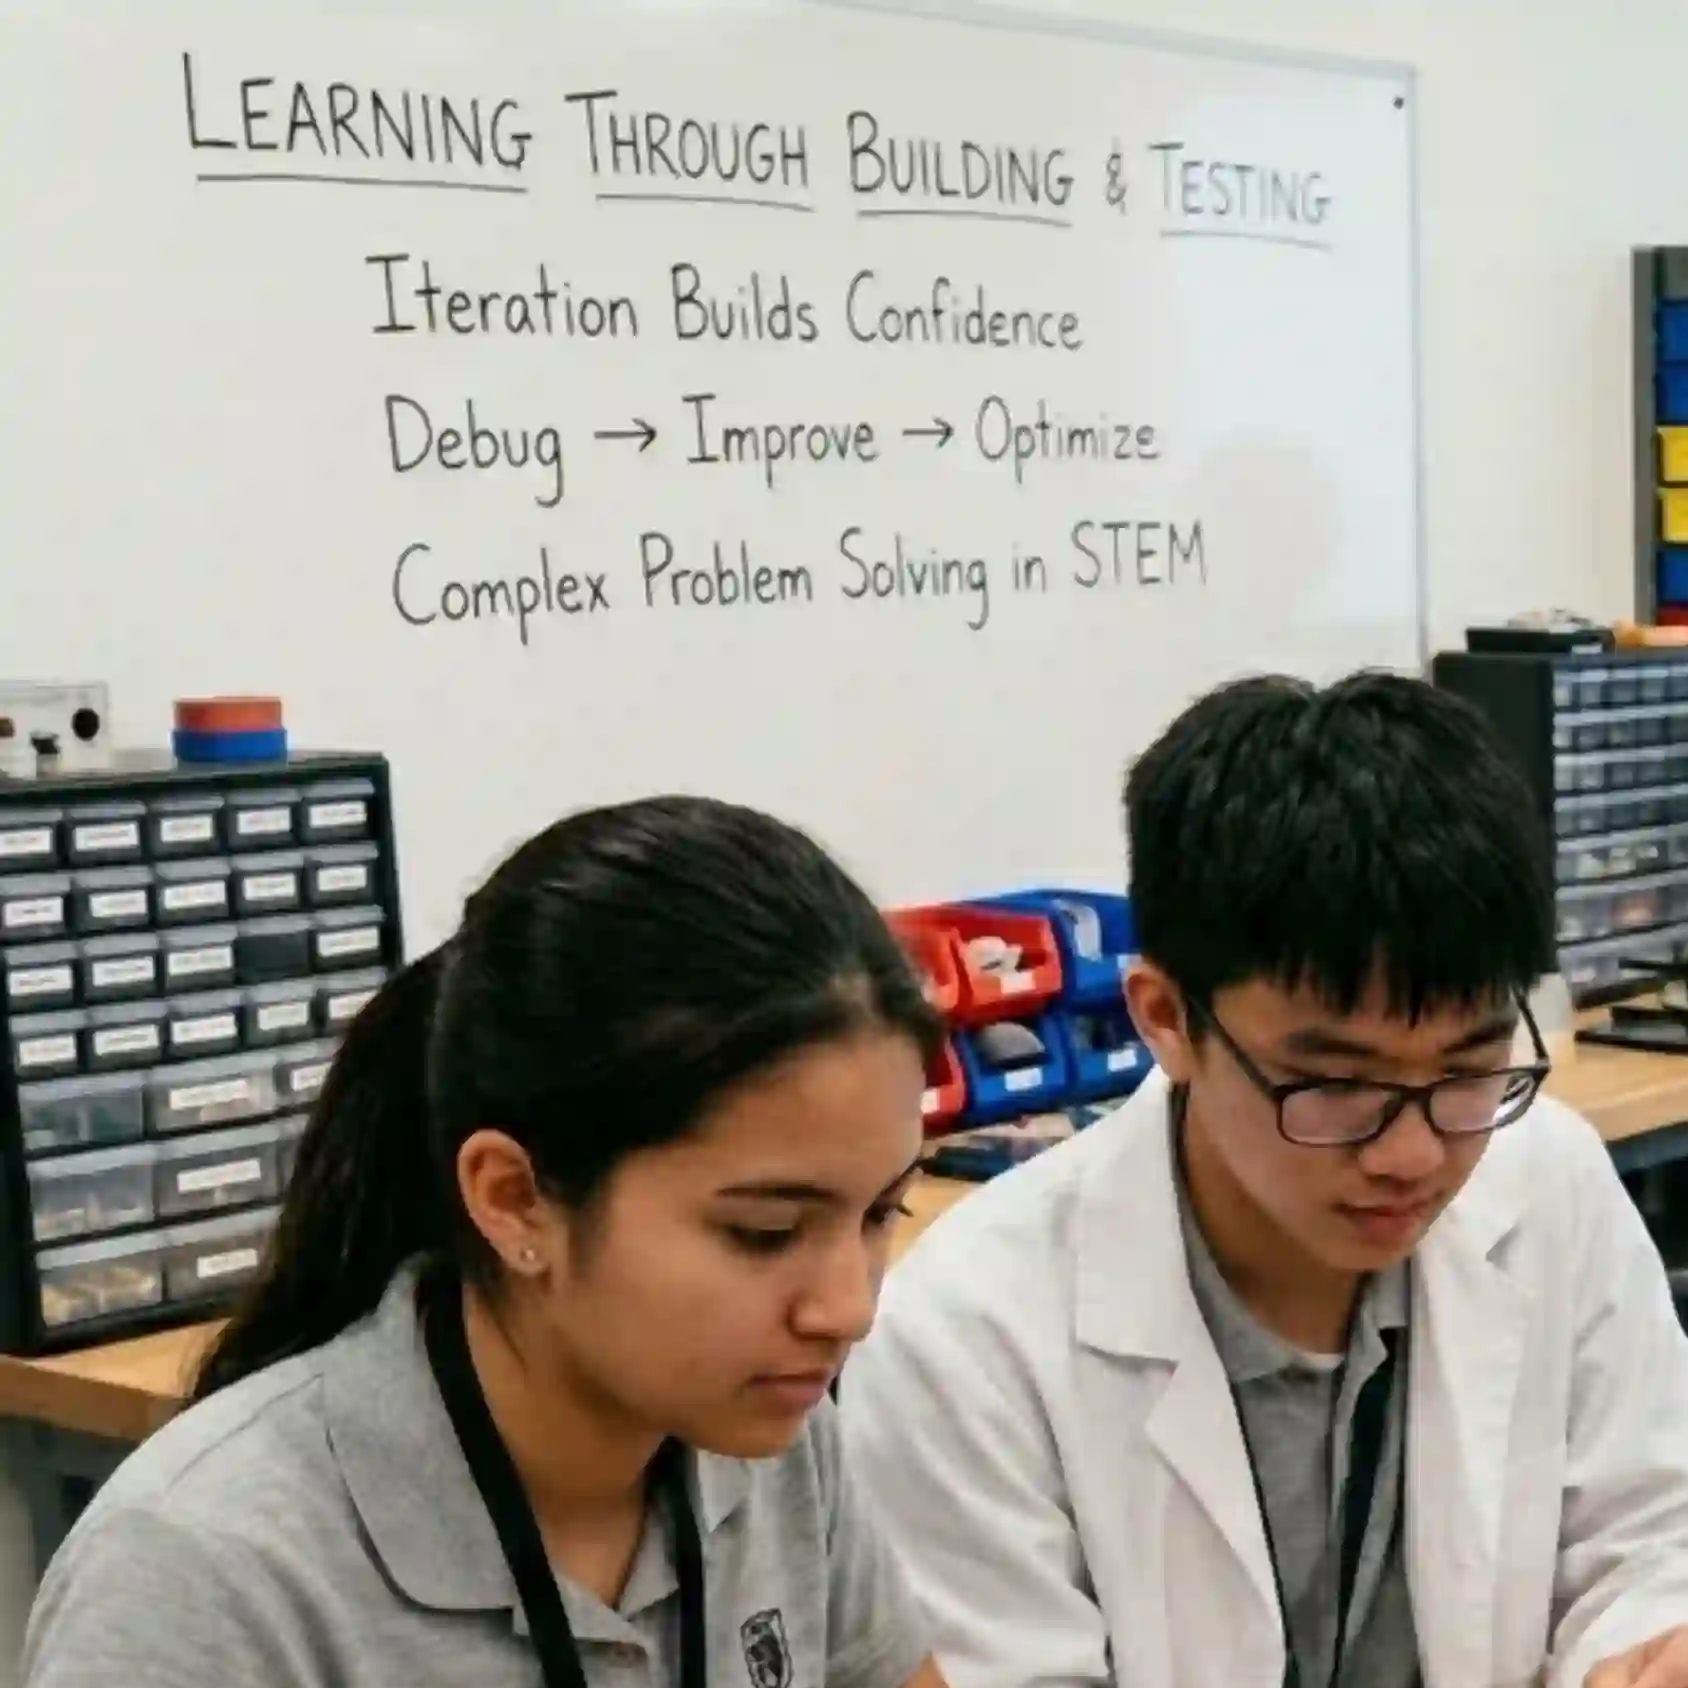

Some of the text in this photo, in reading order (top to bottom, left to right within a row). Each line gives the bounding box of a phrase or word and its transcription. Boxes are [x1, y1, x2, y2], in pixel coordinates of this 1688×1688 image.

[182, 51, 1332, 226] LEARNING THROUGH BUILDING & TESTING
[364, 252, 1084, 351] Iteration Builds Confidence
[384, 392, 1161, 509] Debug Improve Optimize
[392, 519, 1206, 647] Complex Problem Solving in STEM
